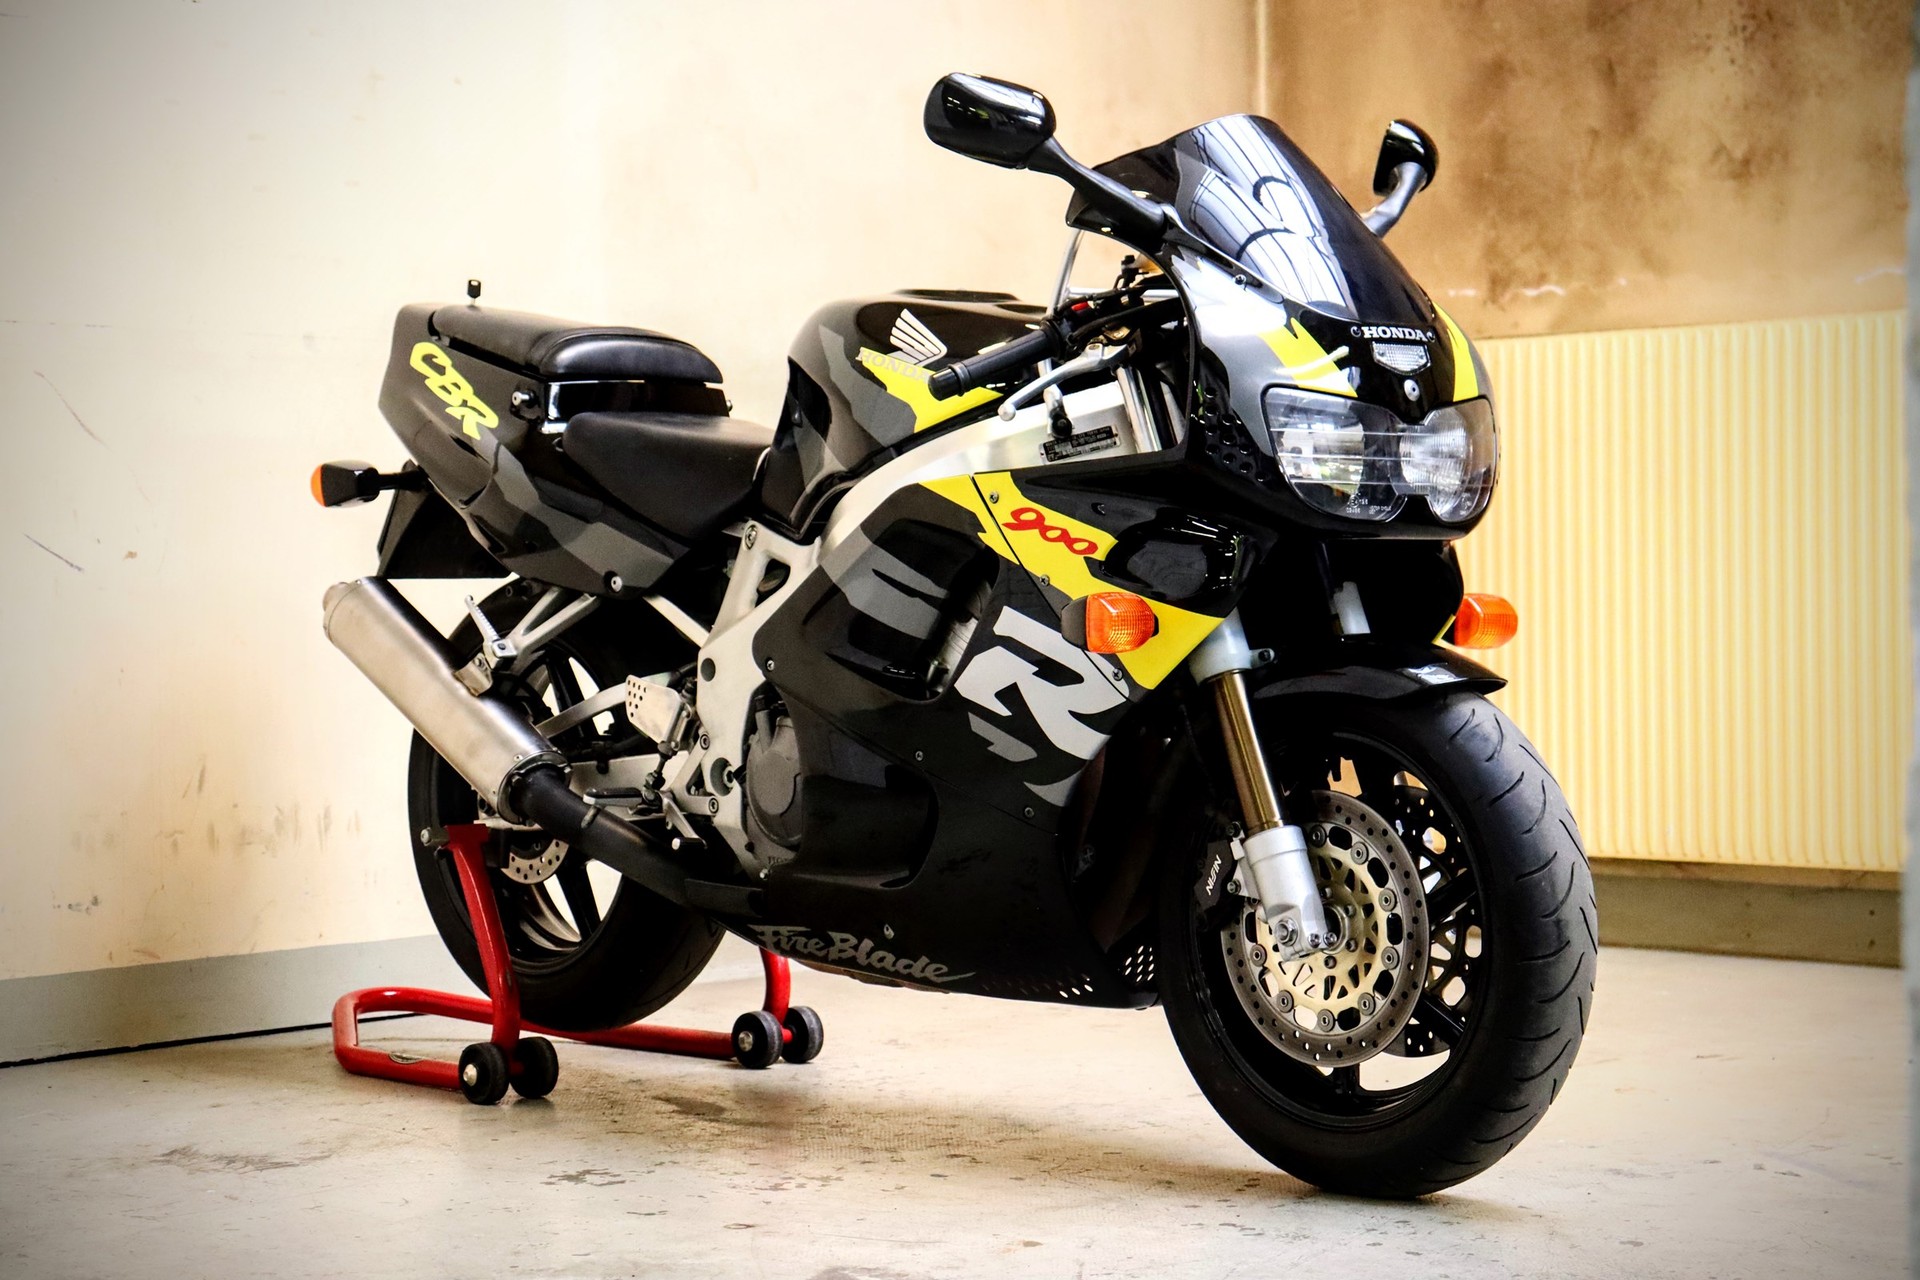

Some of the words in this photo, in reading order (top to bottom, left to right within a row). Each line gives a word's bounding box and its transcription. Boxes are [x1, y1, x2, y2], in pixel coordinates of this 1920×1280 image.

[1361, 326, 1428, 341] HONDA
[410, 341, 499, 440] CBR
[1002, 507, 1098, 555] 900
